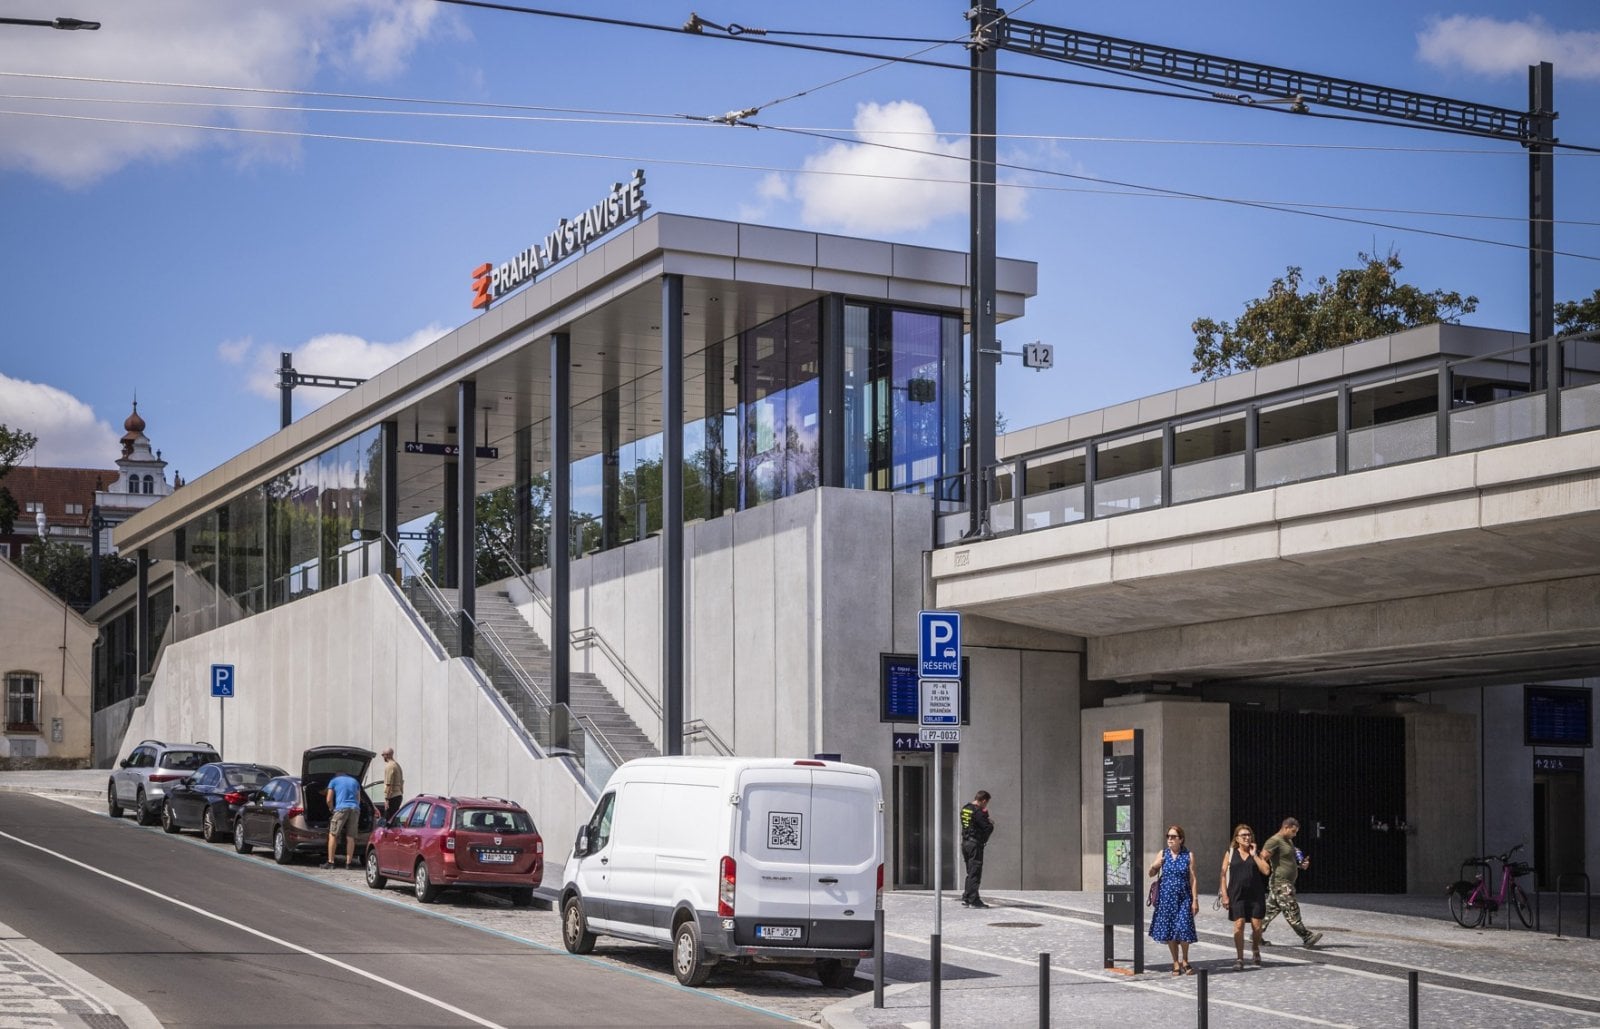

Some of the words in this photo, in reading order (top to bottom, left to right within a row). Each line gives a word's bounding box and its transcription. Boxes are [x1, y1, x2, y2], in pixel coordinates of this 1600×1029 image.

[491, 169, 647, 296] PRAHA-VÝSTAVIŠTĚ
[1032, 347, 1050, 365] 1,2
[490, 448, 496, 457] 1
[930, 620, 953, 657] P
[922, 660, 957, 670] RÉSERVÉ
[216, 668, 229, 687] P
[929, 731, 957, 740] P7-0032
[906, 738, 912, 748] 1
[1543, 759, 1549, 769] 2
[763, 927, 776, 936] 1AF
[780, 928, 798, 937] J827
